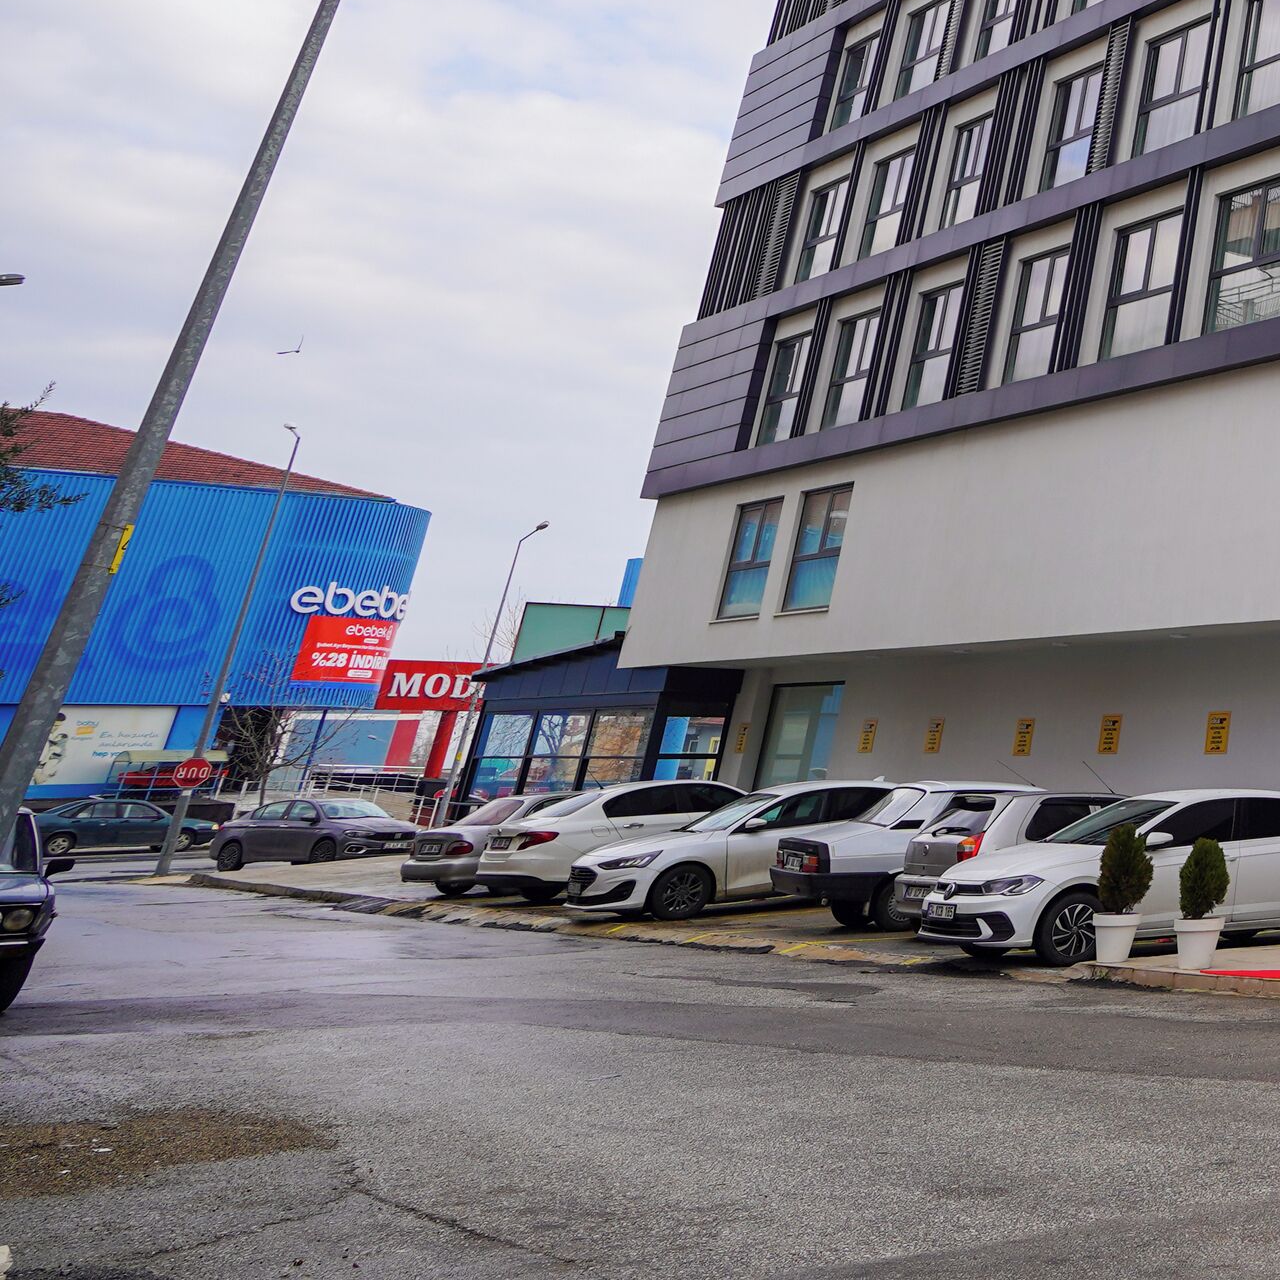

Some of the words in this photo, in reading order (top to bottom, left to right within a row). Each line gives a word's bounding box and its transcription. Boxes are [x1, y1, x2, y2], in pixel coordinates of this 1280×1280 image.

[345, 623, 387, 638] ebebek
[311, 652, 348, 669] %28
[387, 672, 487, 698] MOD
[176, 767, 209, 779] DUR
